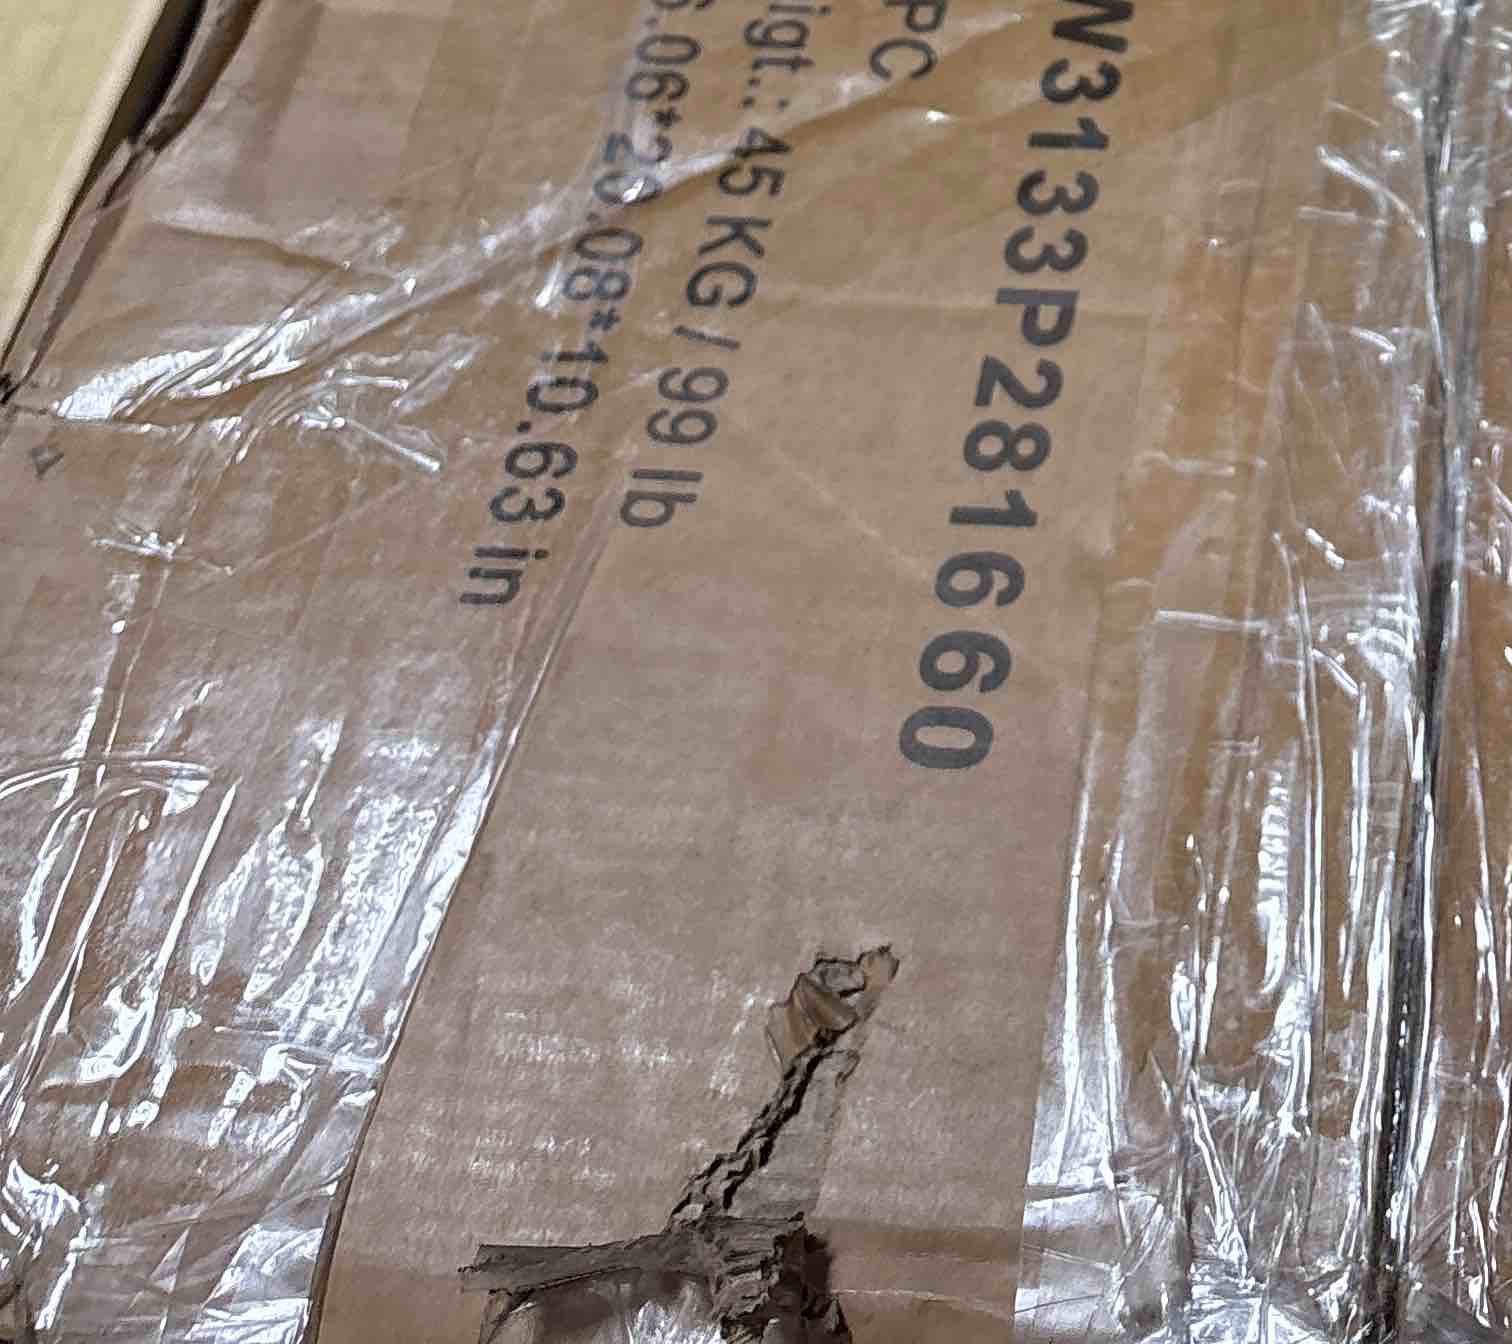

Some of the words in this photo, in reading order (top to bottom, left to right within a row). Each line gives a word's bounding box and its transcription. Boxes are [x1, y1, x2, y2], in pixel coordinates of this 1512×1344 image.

[717, 126, 792, 197] 45
[685, 216, 773, 309] KG
[646, 367, 730, 448] 99
[619, 468, 704, 529] lb
[458, 546, 549, 608] in
